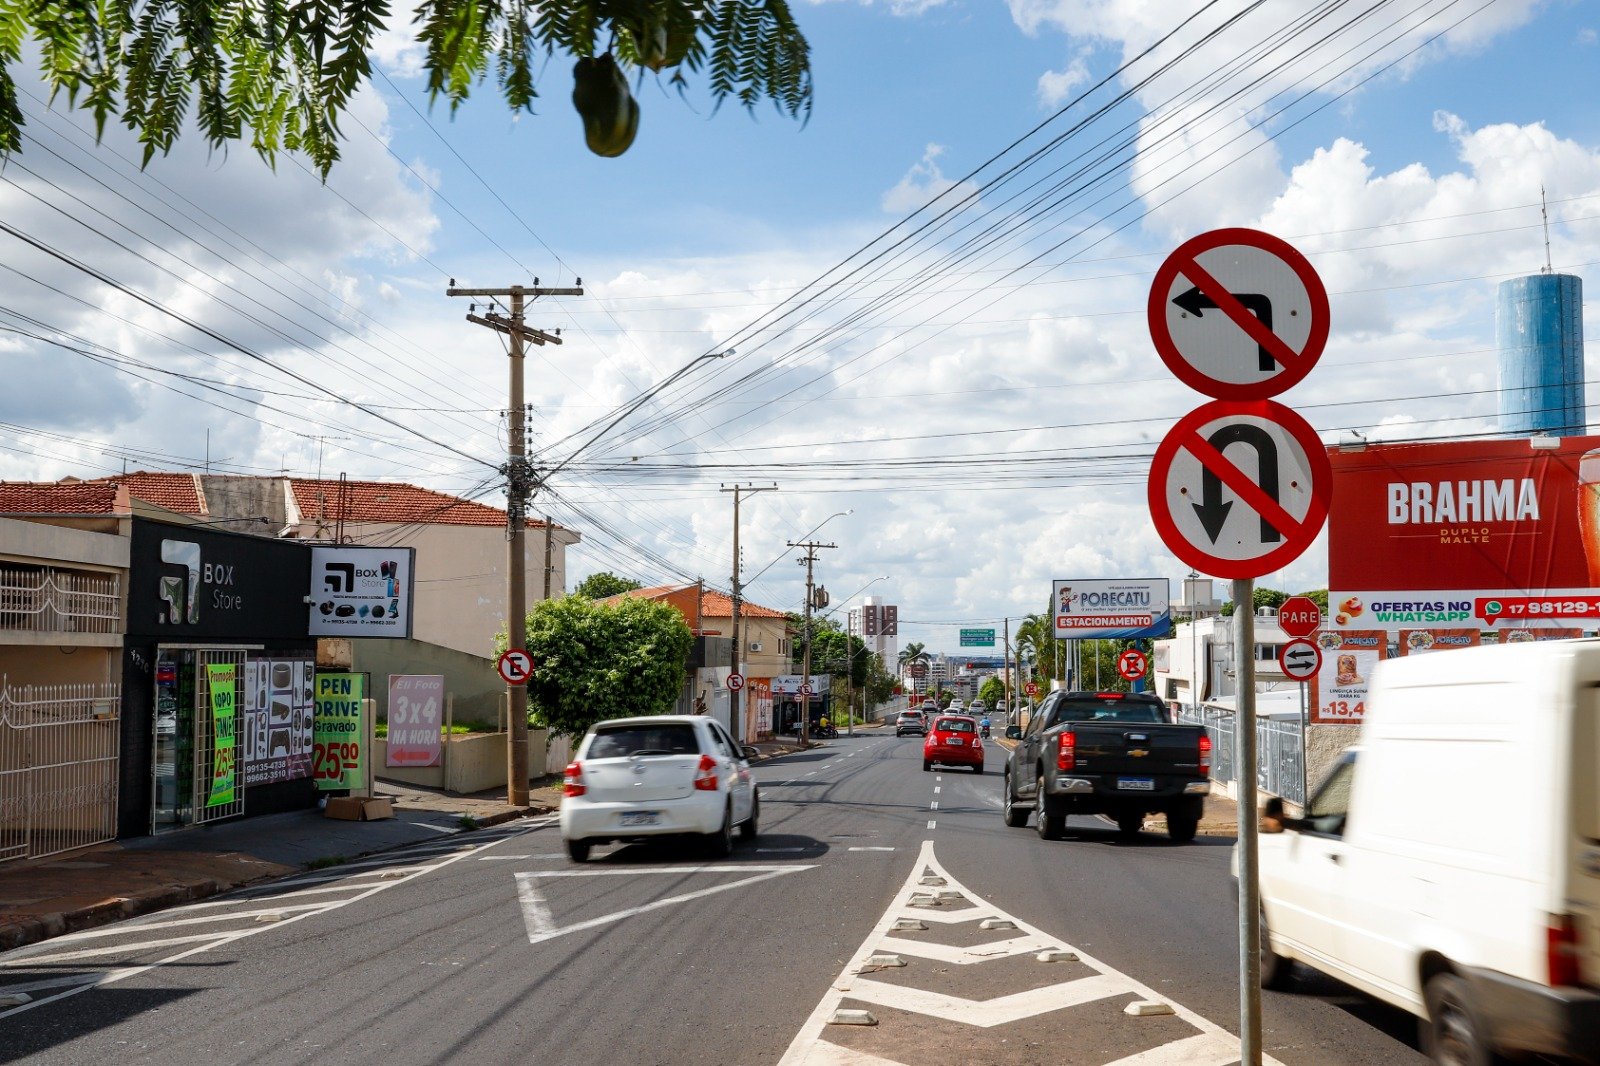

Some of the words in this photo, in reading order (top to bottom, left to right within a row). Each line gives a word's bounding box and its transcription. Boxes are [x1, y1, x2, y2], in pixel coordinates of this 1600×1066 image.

[1387, 478, 1541, 525] BRAHMA
[1440, 527, 1490, 536] DUPLO
[1440, 535, 1490, 544] MALTE
[203, 563, 234, 586] BOX
[355, 569, 378, 578] BOX
[361, 579, 386, 588] Store
[212, 589, 242, 610] Store
[1080, 591, 1150, 607] PORECATU
[1371, 601, 1445, 612] OFERTAS
[1448, 601, 1472, 612] NO
[1509, 605, 1525, 614] 17
[1060, 616, 1151, 627] ESTACIONAMENTO
[1281, 611, 1318, 624] PARE
[1376, 611, 1470, 622] WHATSAPP
[321, 678, 351, 695] PEN
[414, 680, 440, 690] Foto
[314, 701, 359, 717] DRIVE
[393, 695, 438, 724] 3x4
[1329, 701, 1367, 717] 13,4
[314, 721, 356, 733] Gravado
[392, 730, 407, 745] NA
[409, 729, 437, 745] HORA
[246, 760, 286, 774] 99135-4738
[246, 769, 286, 783] 99662-3510
